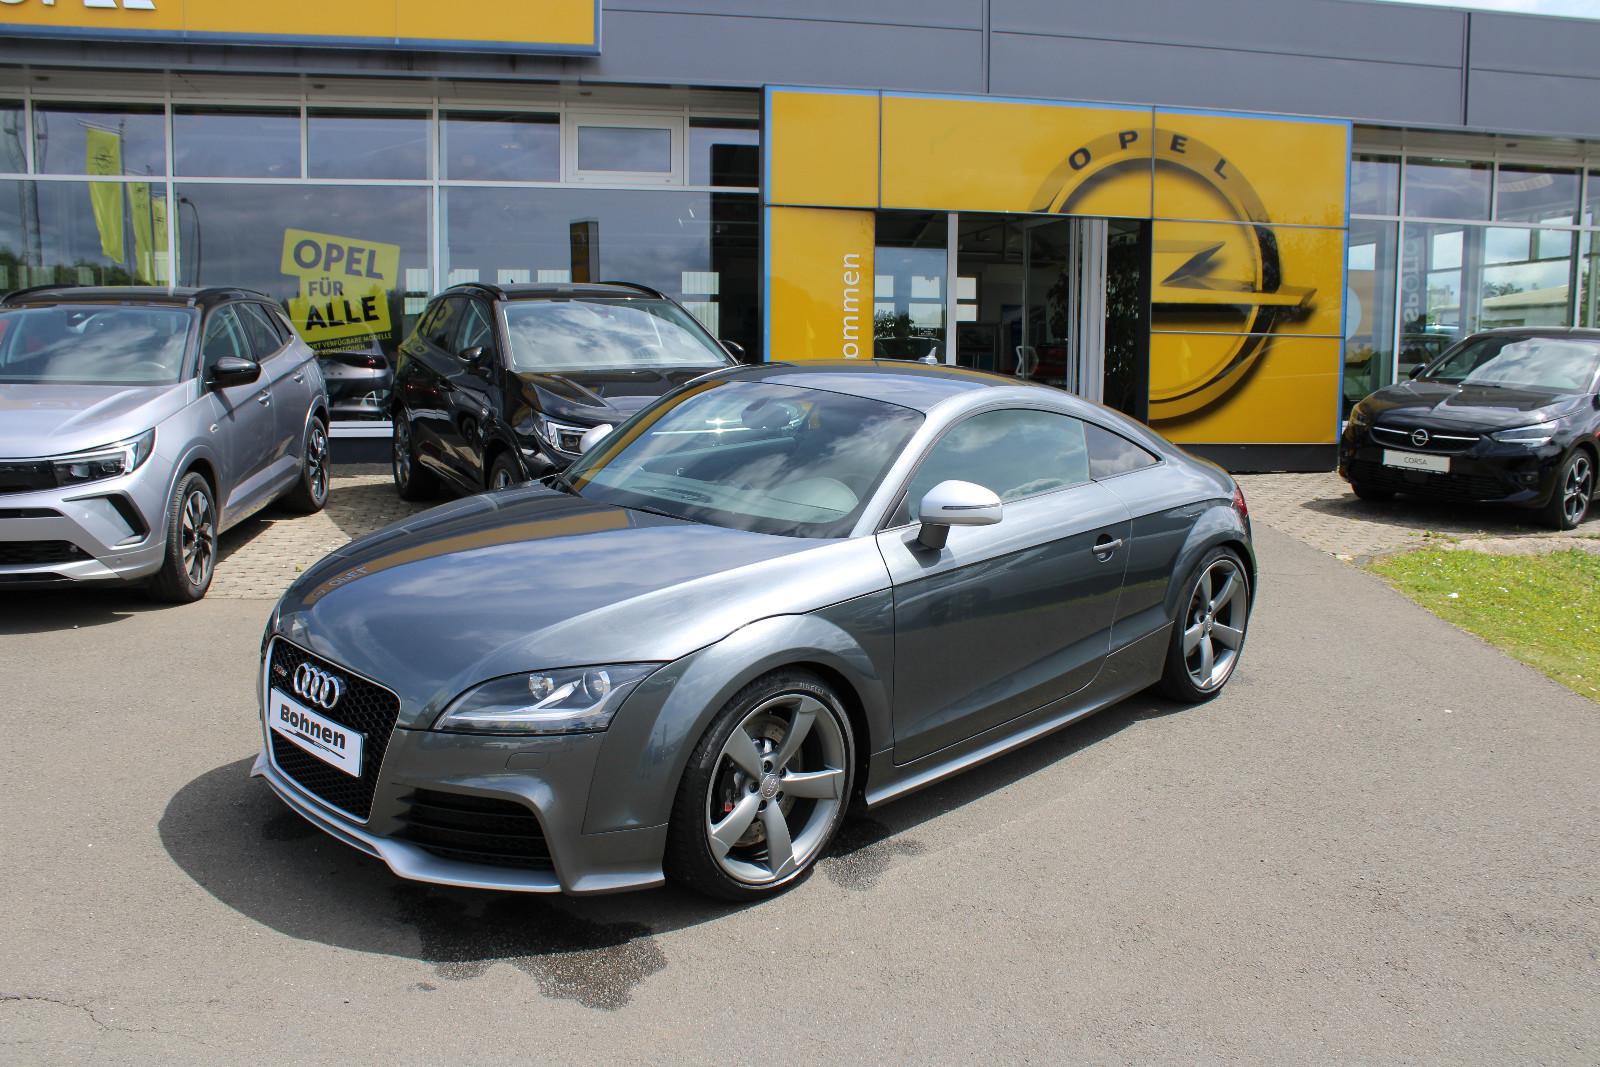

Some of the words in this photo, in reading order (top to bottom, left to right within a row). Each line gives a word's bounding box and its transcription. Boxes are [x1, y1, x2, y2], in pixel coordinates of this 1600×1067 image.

[1068, 130, 1228, 180] OPEL
[293, 239, 384, 280] OPEL
[308, 277, 344, 297] FÜR
[843, 253, 860, 359] ommen
[305, 296, 379, 331] ALLE
[322, 336, 362, 348] VERFÜGBARE
[1404, 456, 1428, 465] CORSA
[280, 703, 346, 750] Bohnen
